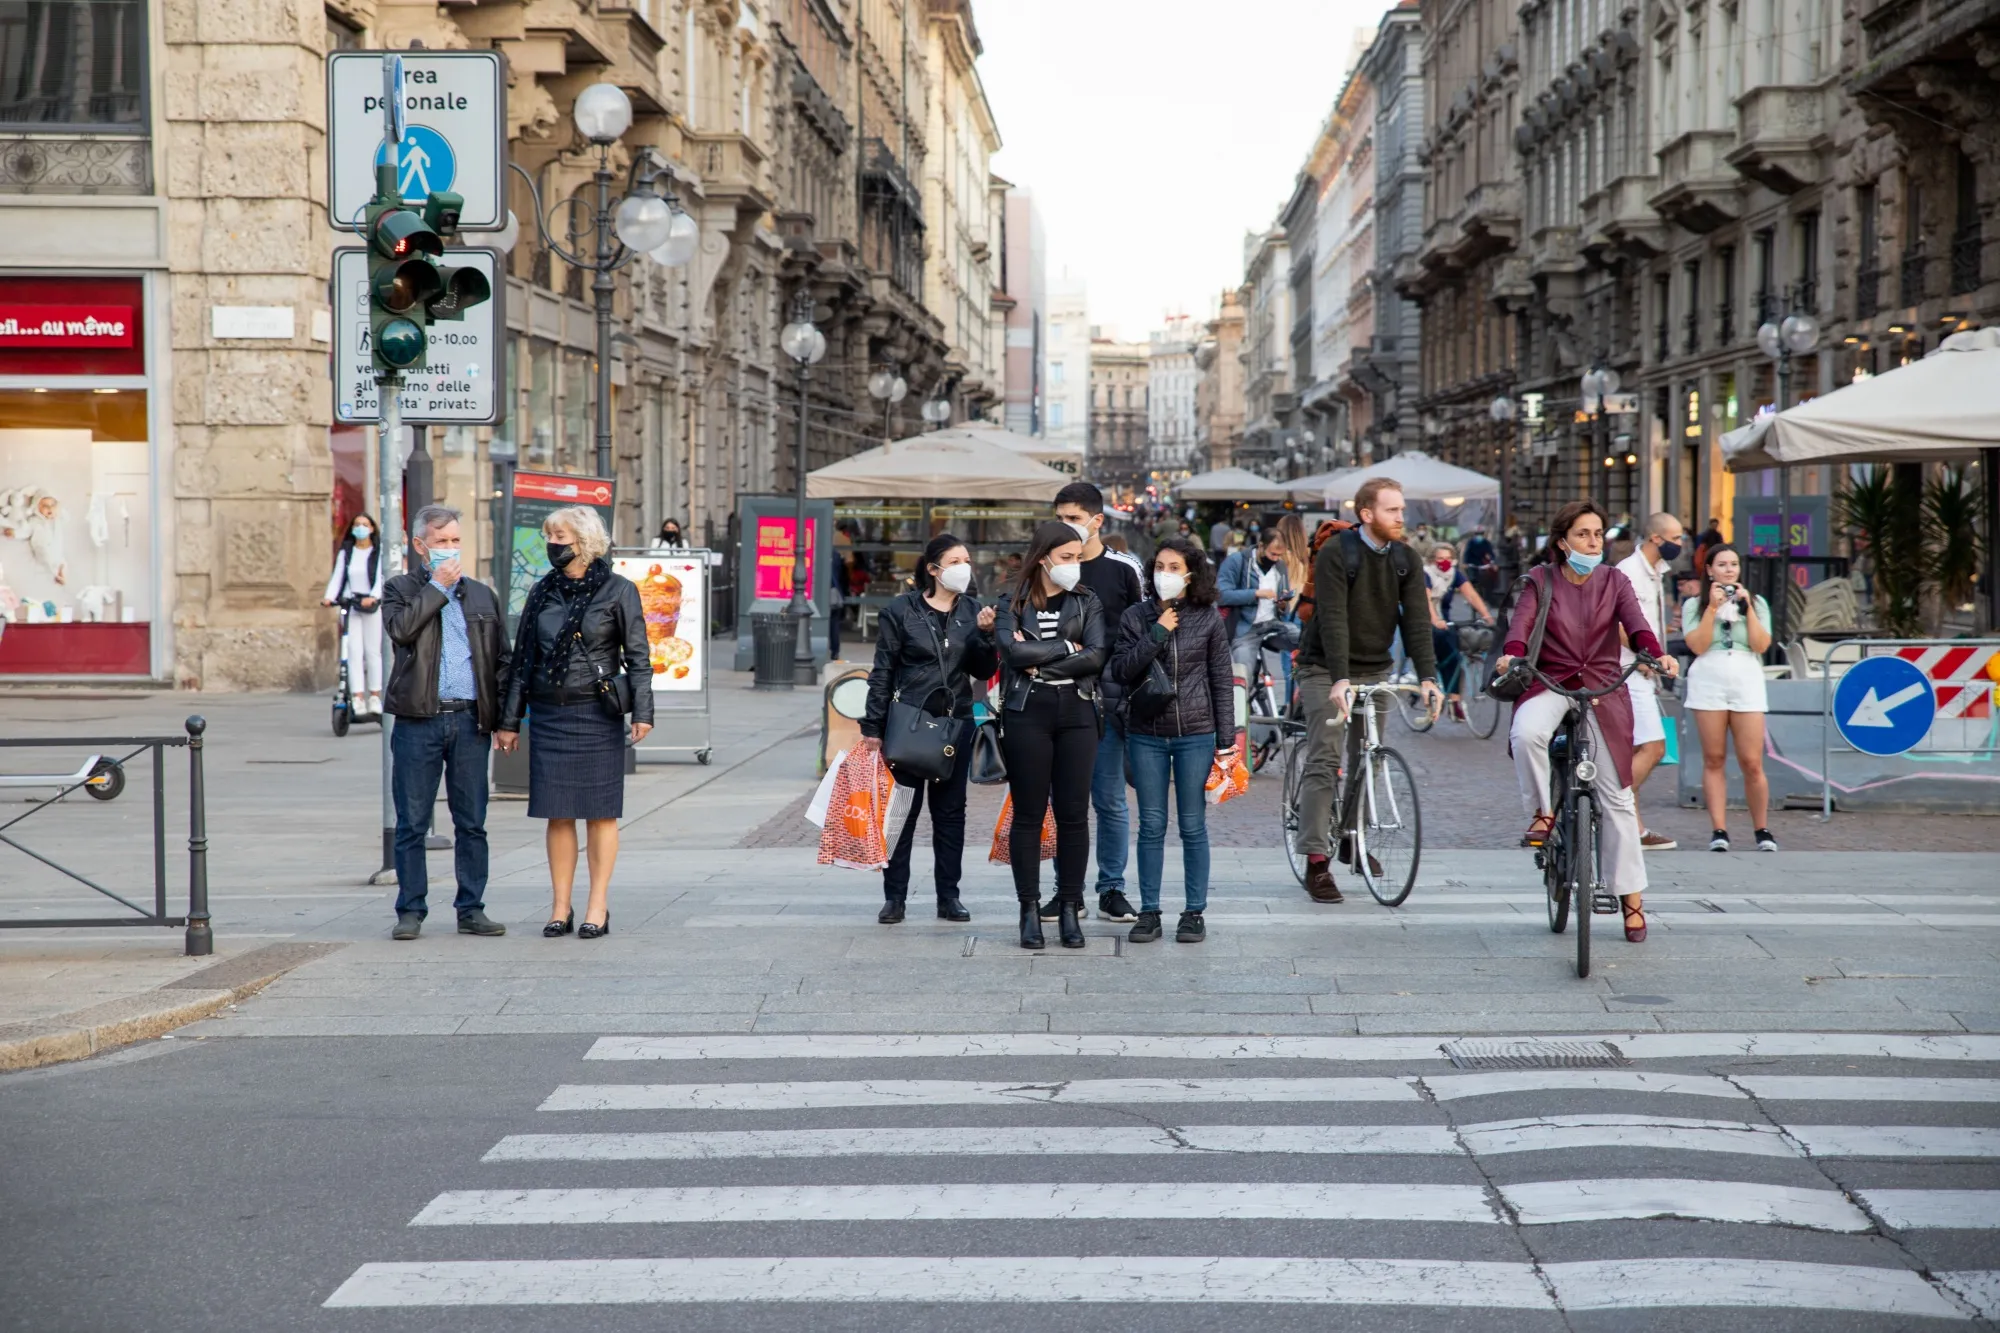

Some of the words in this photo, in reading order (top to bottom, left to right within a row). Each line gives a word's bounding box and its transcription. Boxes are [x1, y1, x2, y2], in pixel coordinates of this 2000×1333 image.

[404, 70, 437, 84] rea
[364, 92, 467, 113] peonale
[66, 315, 125, 336] même
[436, 380, 471, 392] delle
